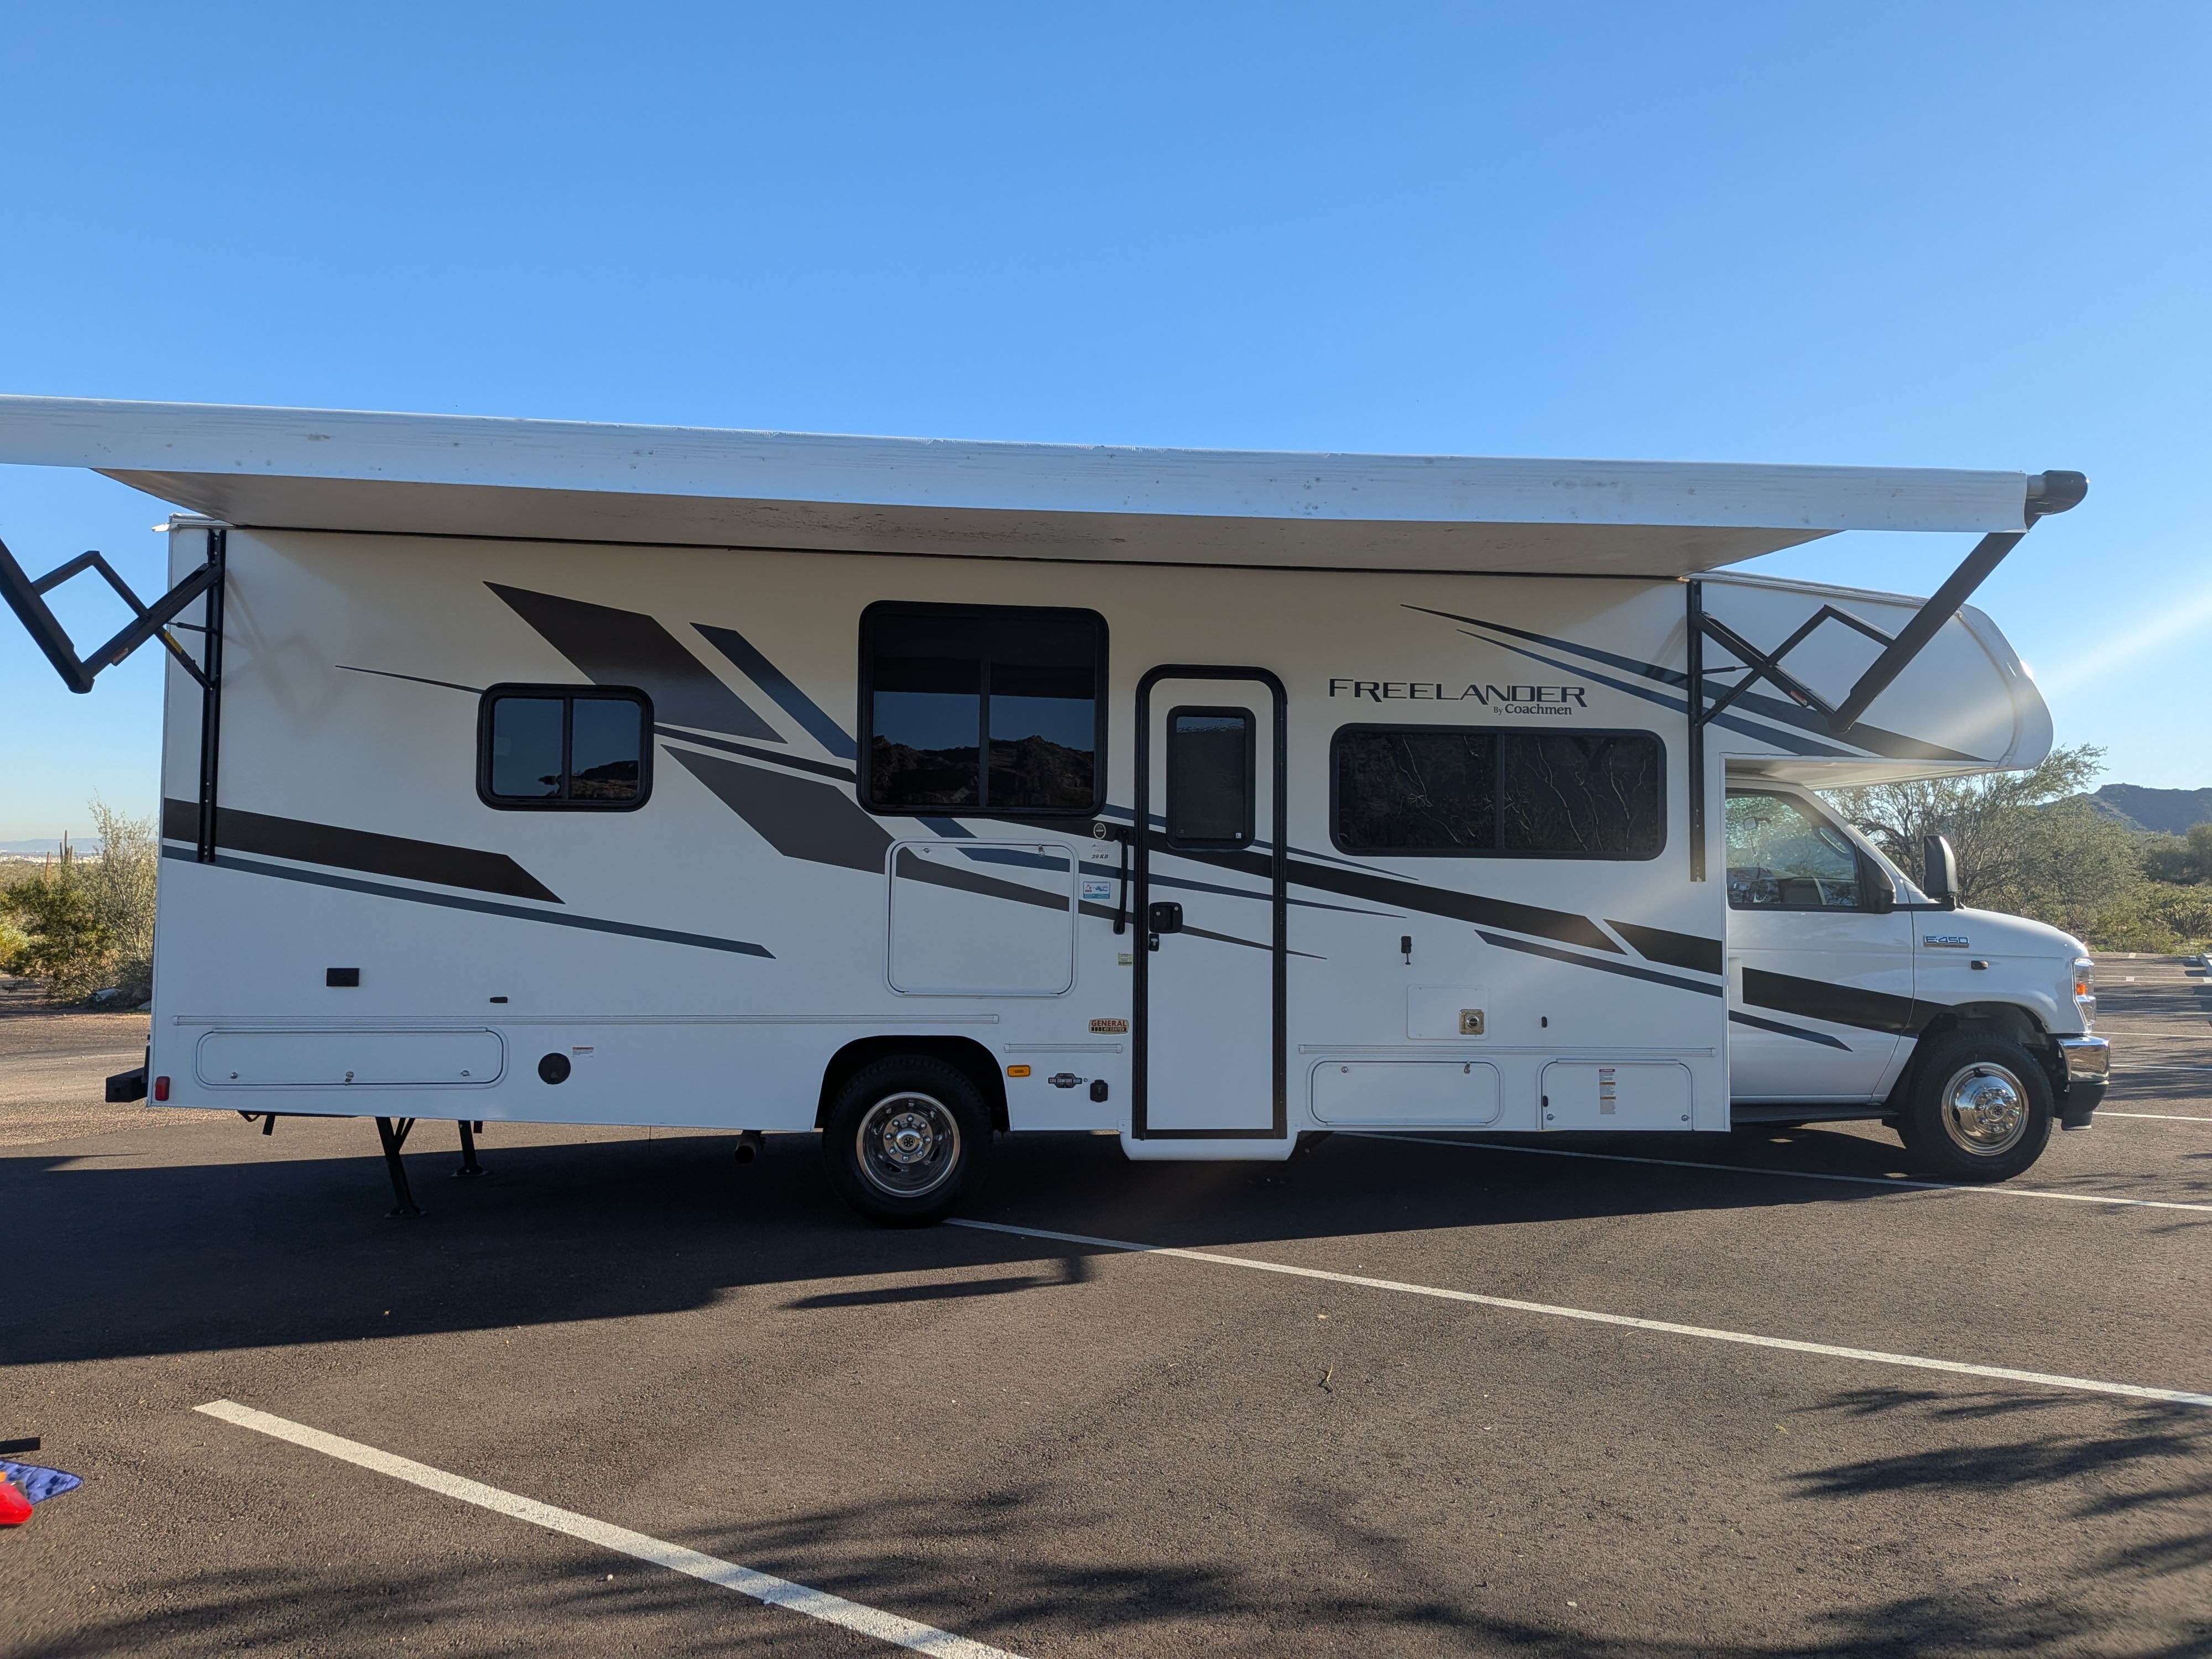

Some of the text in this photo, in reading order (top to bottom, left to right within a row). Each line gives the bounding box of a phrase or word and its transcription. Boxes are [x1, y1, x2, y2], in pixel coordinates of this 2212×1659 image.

[1329, 679, 1588, 707] FREELANDER
[1493, 704, 1573, 716] By Coachmen
